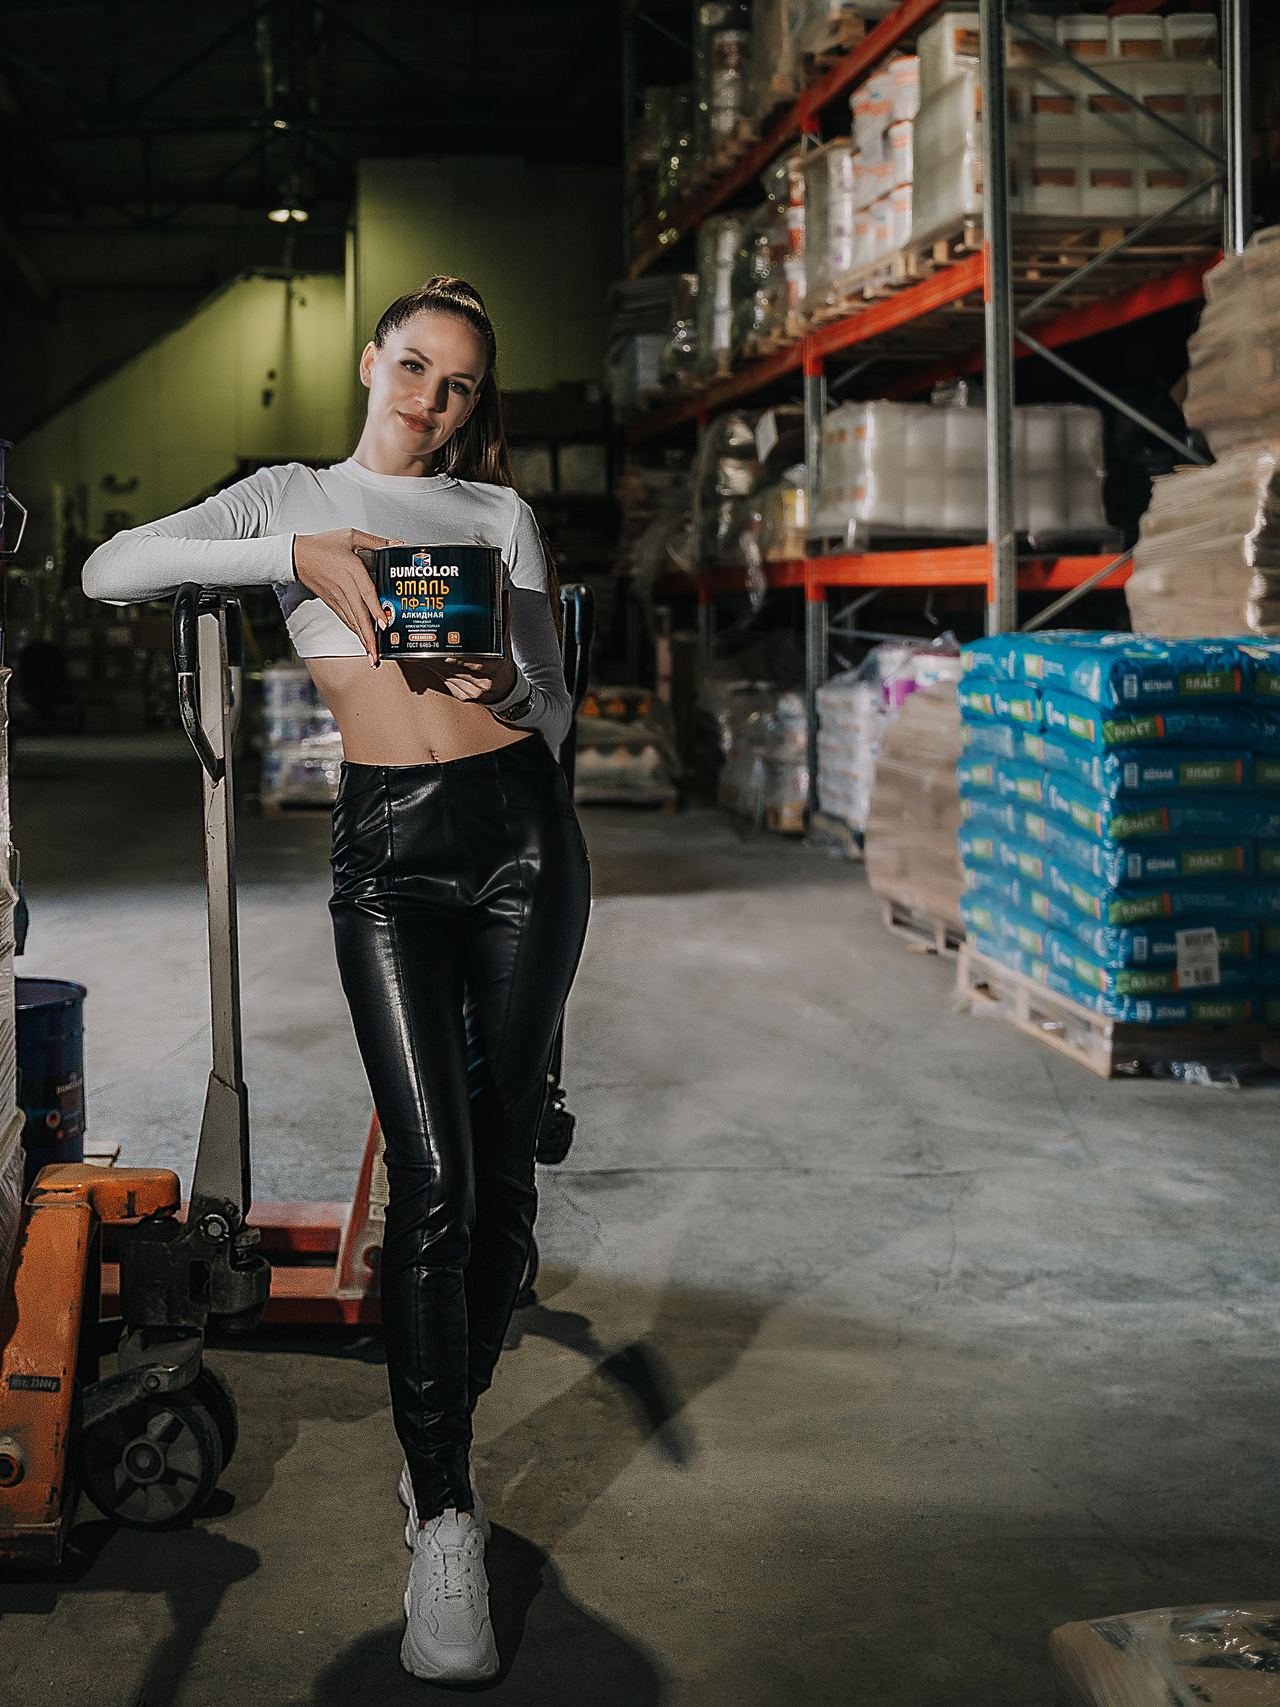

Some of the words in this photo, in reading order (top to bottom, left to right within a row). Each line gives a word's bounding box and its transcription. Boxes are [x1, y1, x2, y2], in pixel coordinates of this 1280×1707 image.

[390, 566, 459, 578] BUMCOLOR
[395, 579, 450, 596] ЭМАЛЬ
[401, 597, 444, 611] ПФ-115
[401, 611, 444, 620] АЛКИДНАЯ
